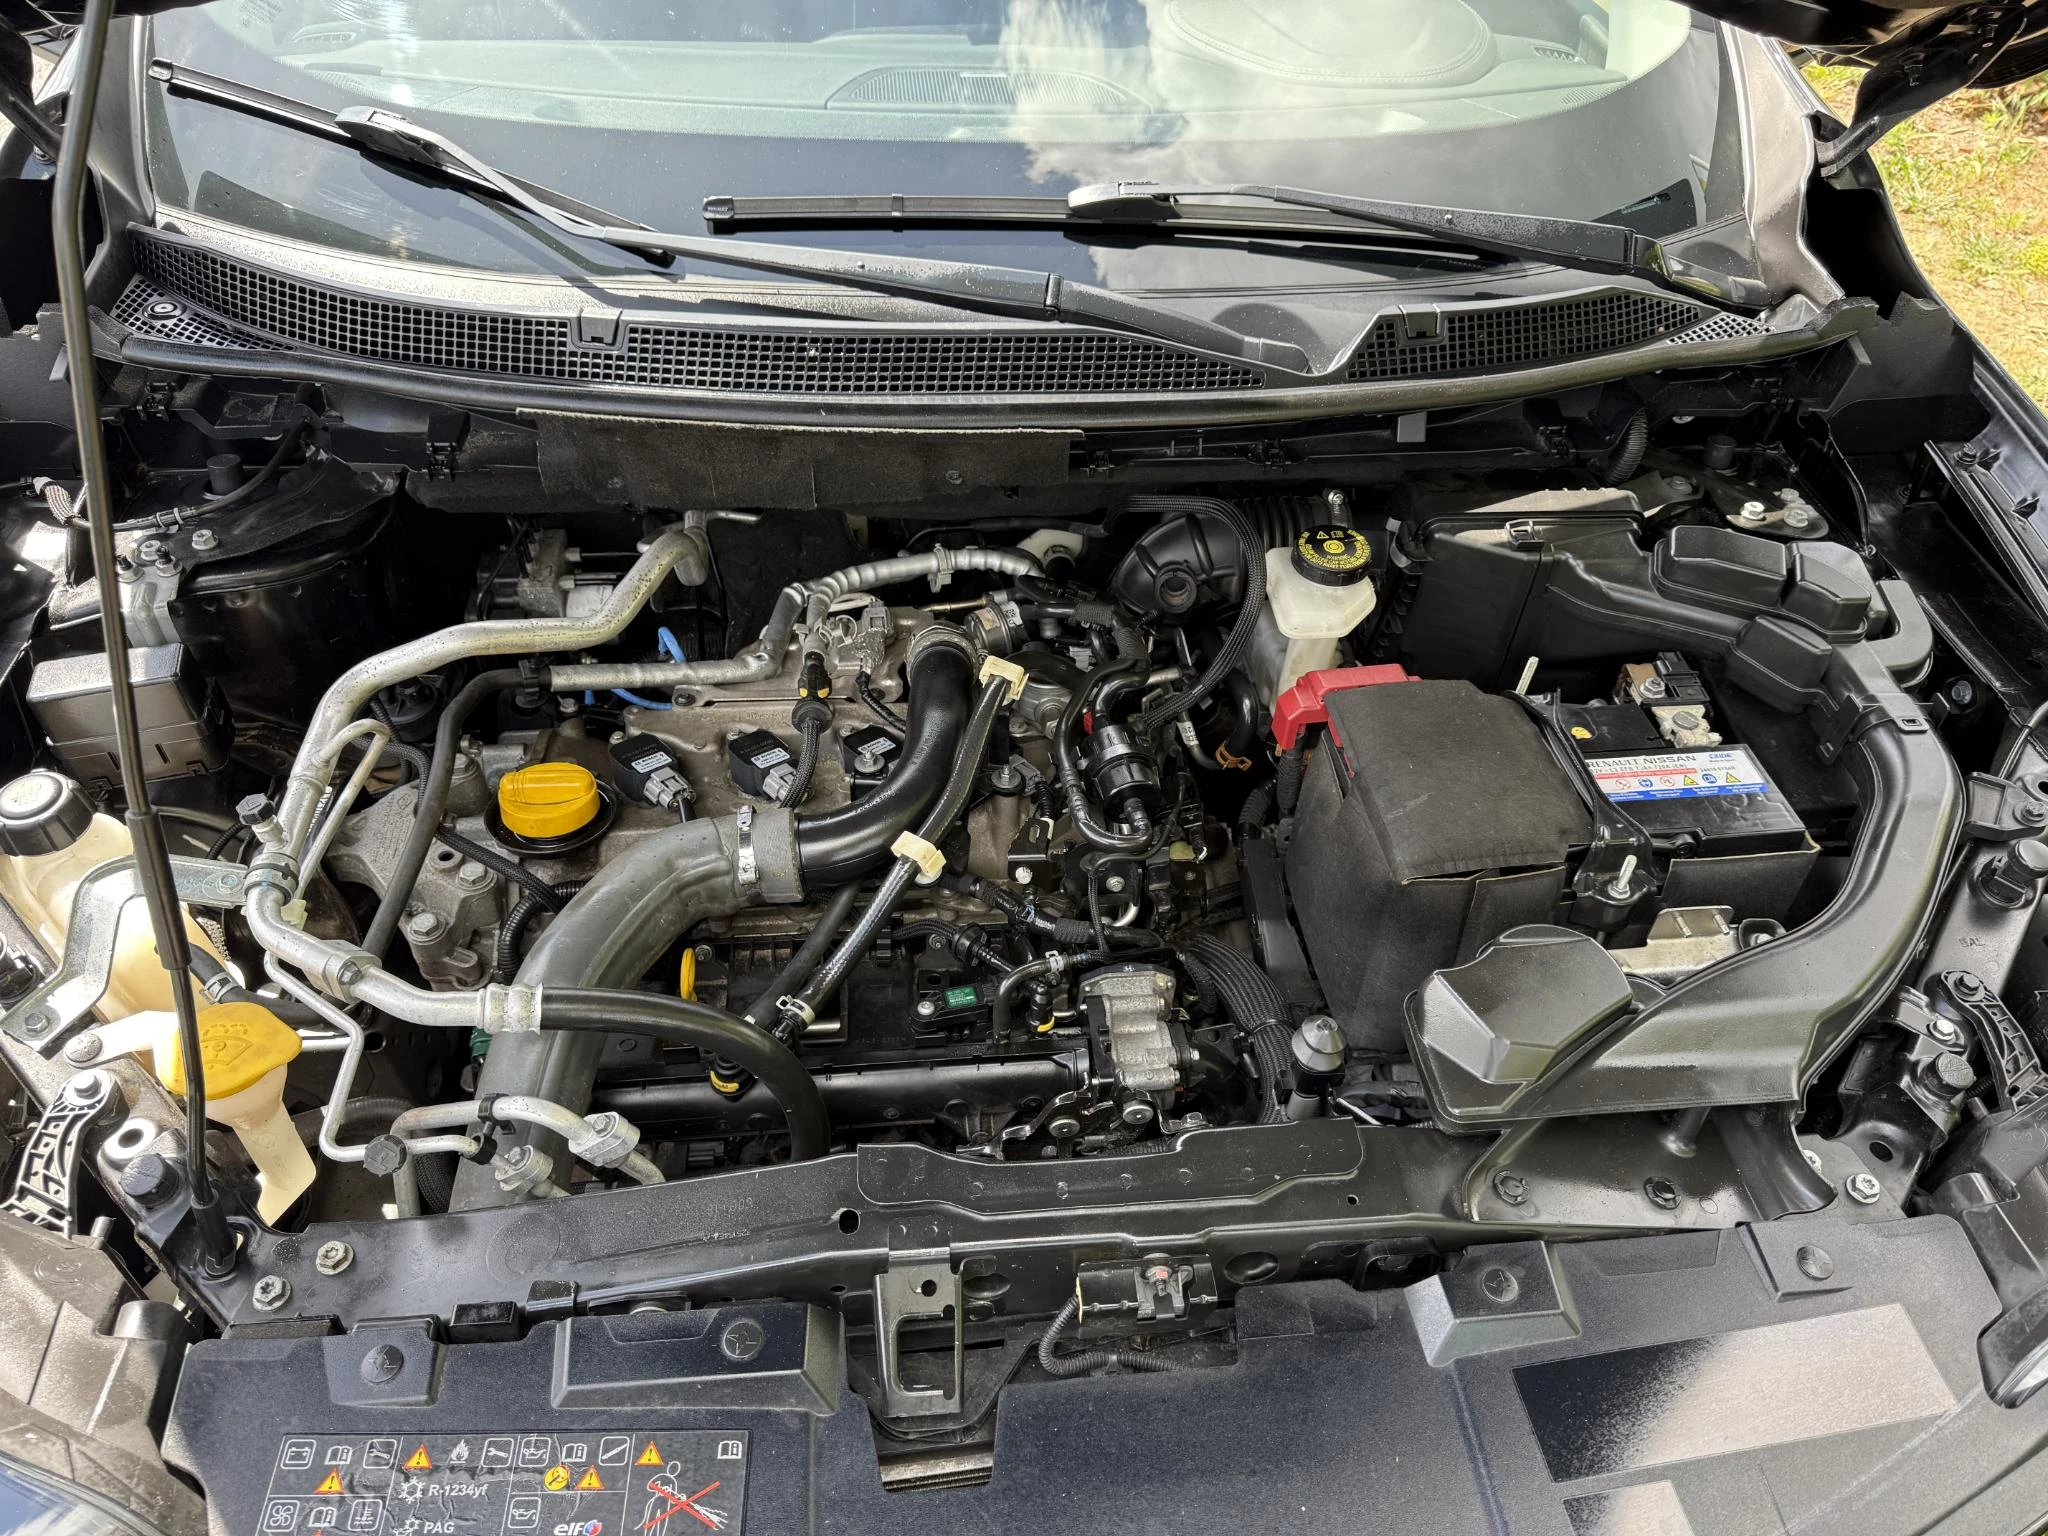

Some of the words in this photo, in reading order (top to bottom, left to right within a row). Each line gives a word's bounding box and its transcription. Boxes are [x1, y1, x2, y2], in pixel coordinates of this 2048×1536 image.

[1586, 759, 1639, 768] RENAULT
[1643, 755, 1697, 764] NISSAN
[428, 1483, 489, 1499] R-1234yf
[423, 1521, 455, 1534] PAG
